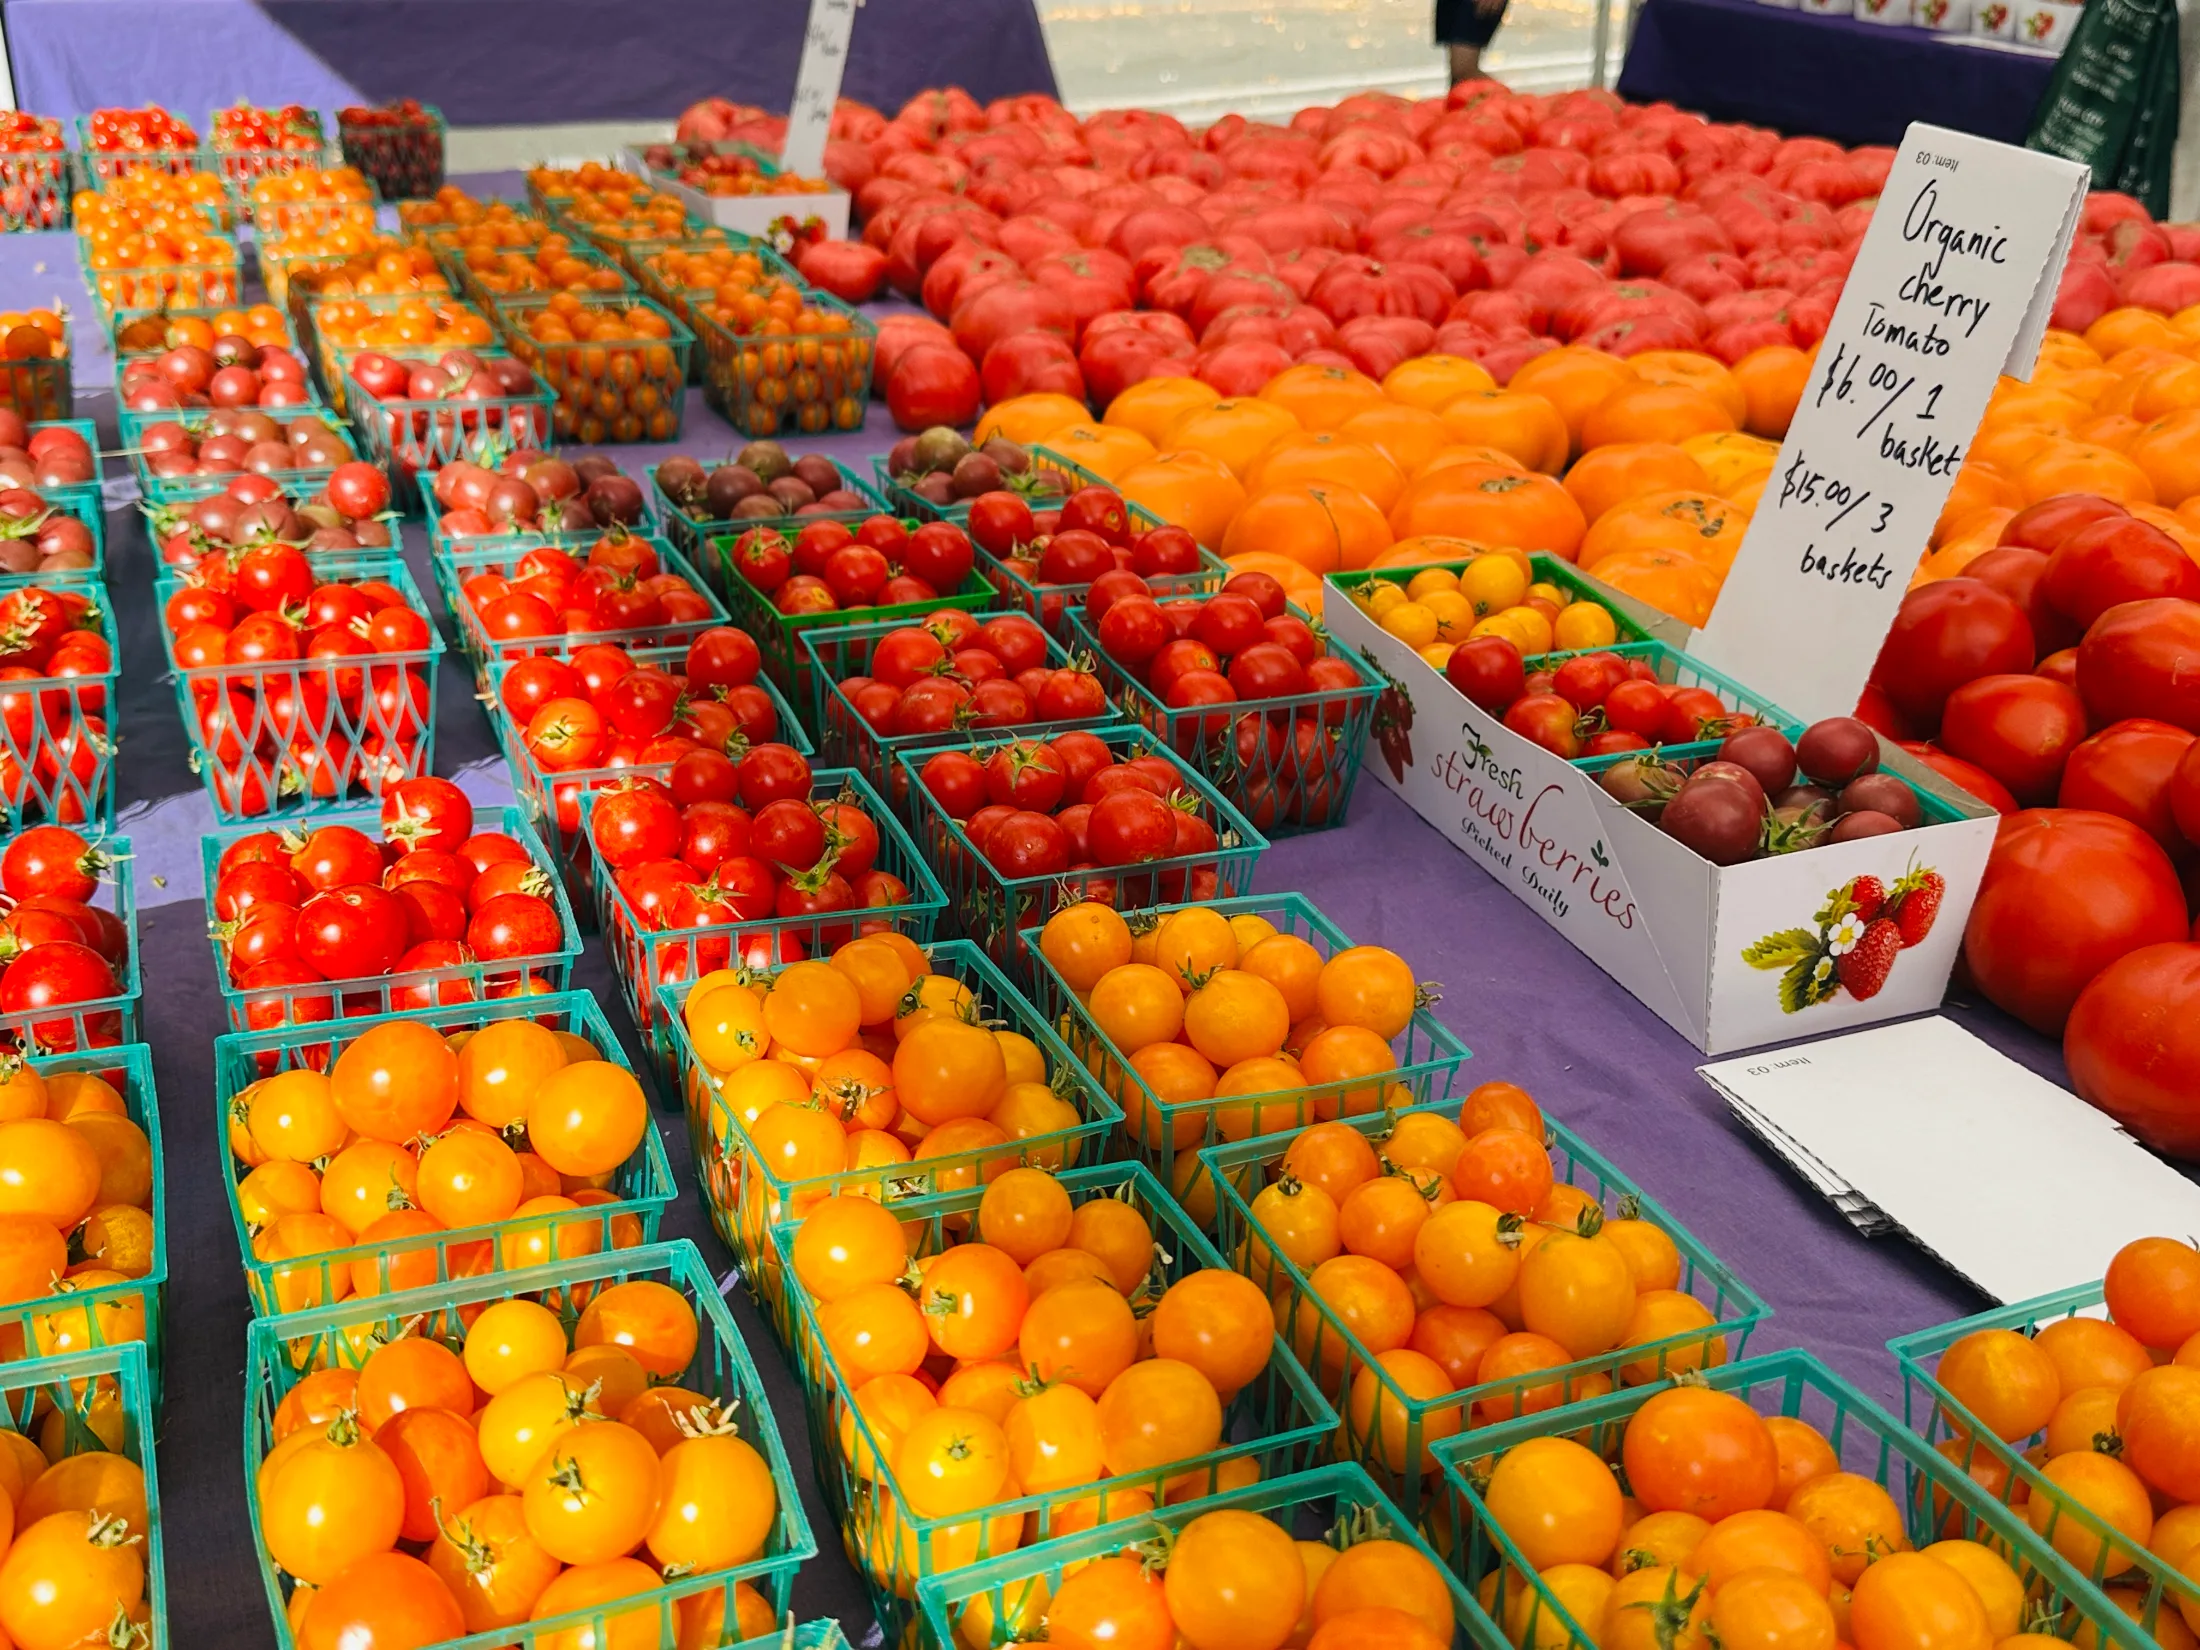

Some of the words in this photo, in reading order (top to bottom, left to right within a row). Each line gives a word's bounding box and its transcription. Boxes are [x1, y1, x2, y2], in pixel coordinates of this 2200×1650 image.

[1915, 151, 1931, 166] 03
[1932, 153, 1960, 173] Item:
[1902, 178, 2008, 281] Organic
[1898, 261, 1991, 339] cherry
[1862, 302, 1950, 356] Tomato
[1879, 421, 1961, 477] basket
[1799, 543, 1893, 590] baskets
[1461, 721, 1524, 800] Fresh
[1430, 749, 1637, 930] strawberries
[1460, 815, 1513, 870] Picked
[1521, 864, 1570, 918] Daily
[1746, 1066, 1770, 1077] 03
[1773, 1056, 1813, 1071] Item:
